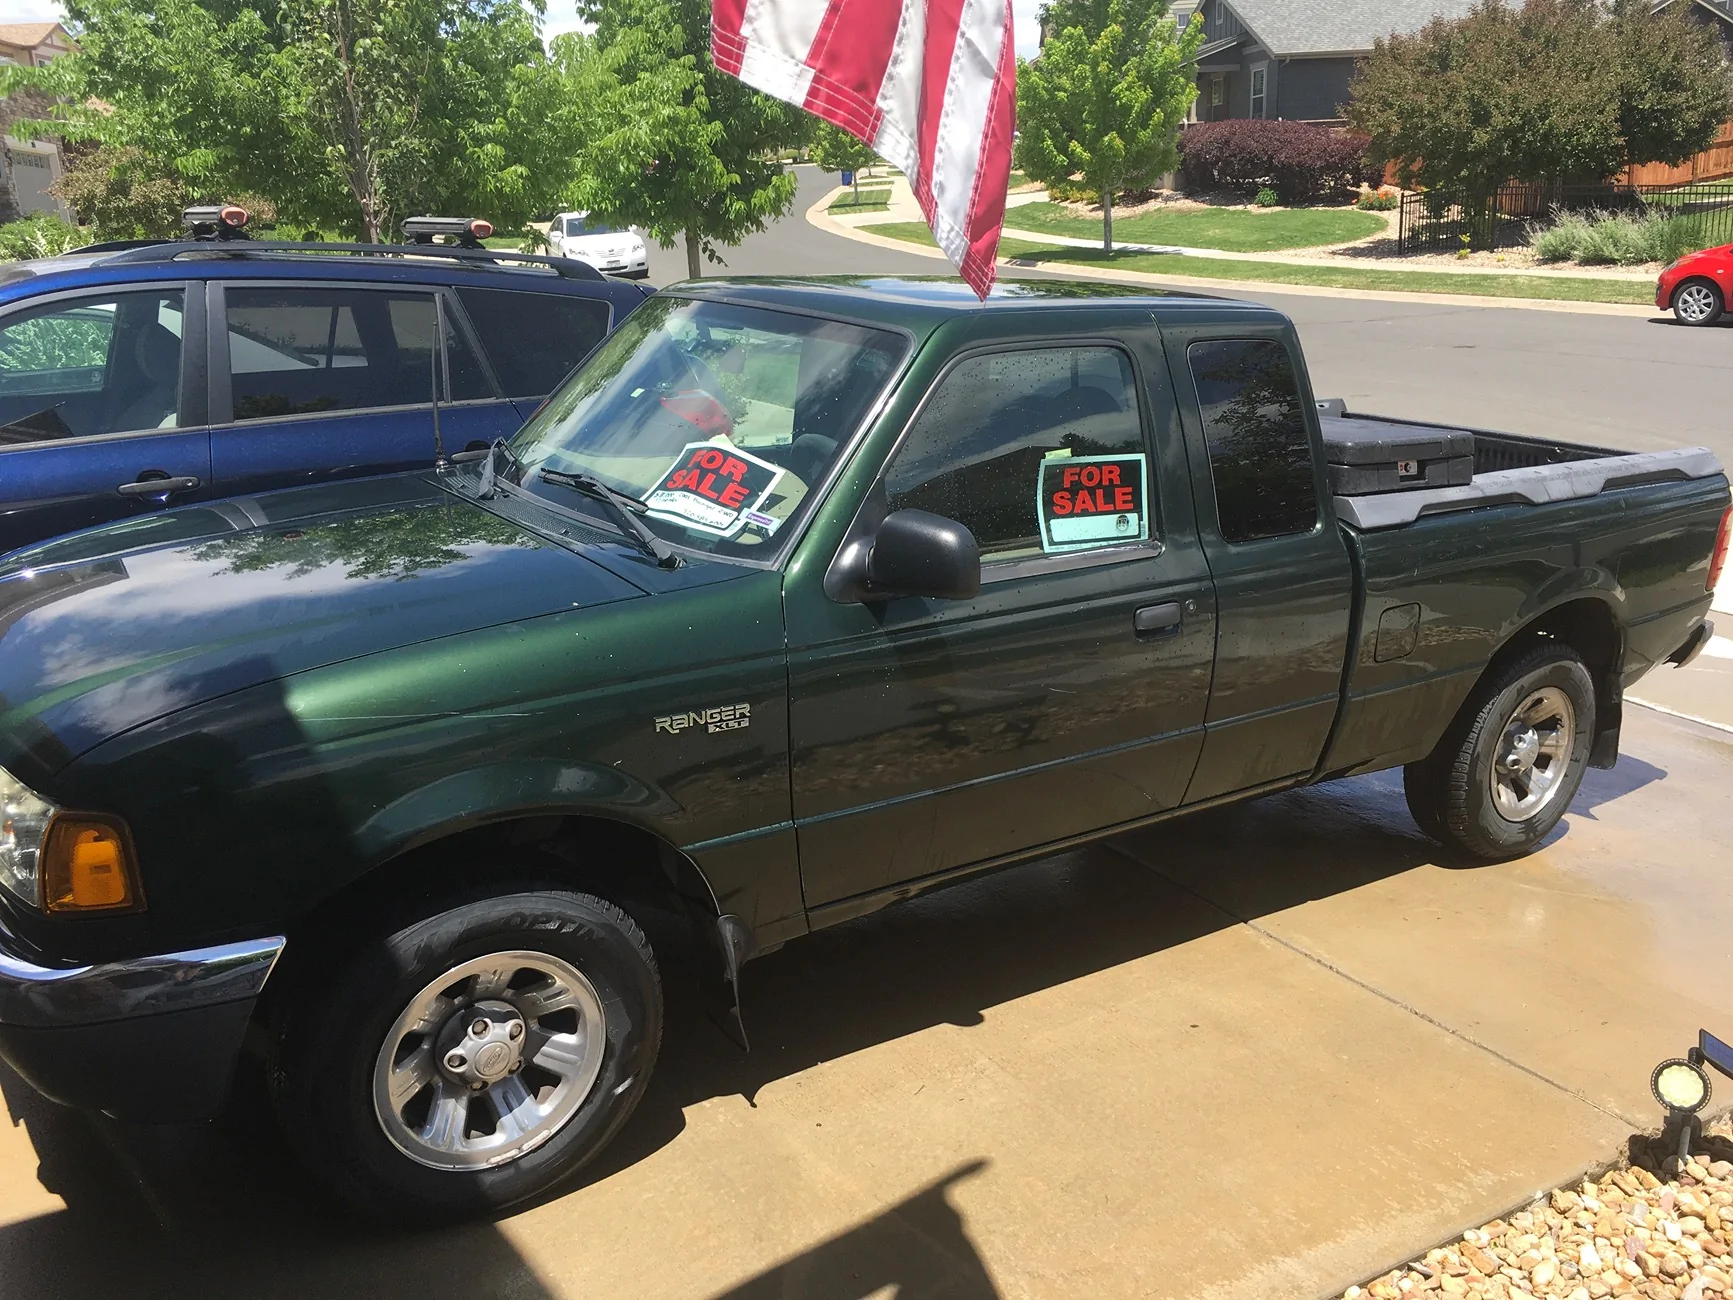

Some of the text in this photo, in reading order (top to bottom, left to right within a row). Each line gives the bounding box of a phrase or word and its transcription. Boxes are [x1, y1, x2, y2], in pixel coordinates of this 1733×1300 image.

[688, 450, 748, 482] FOR
[1063, 465, 1121, 488] FOR
[667, 469, 750, 508] SALE
[1052, 487, 1134, 515] SALE
[654, 702, 751, 734] RANGER
[713, 719, 748, 732] XLT
